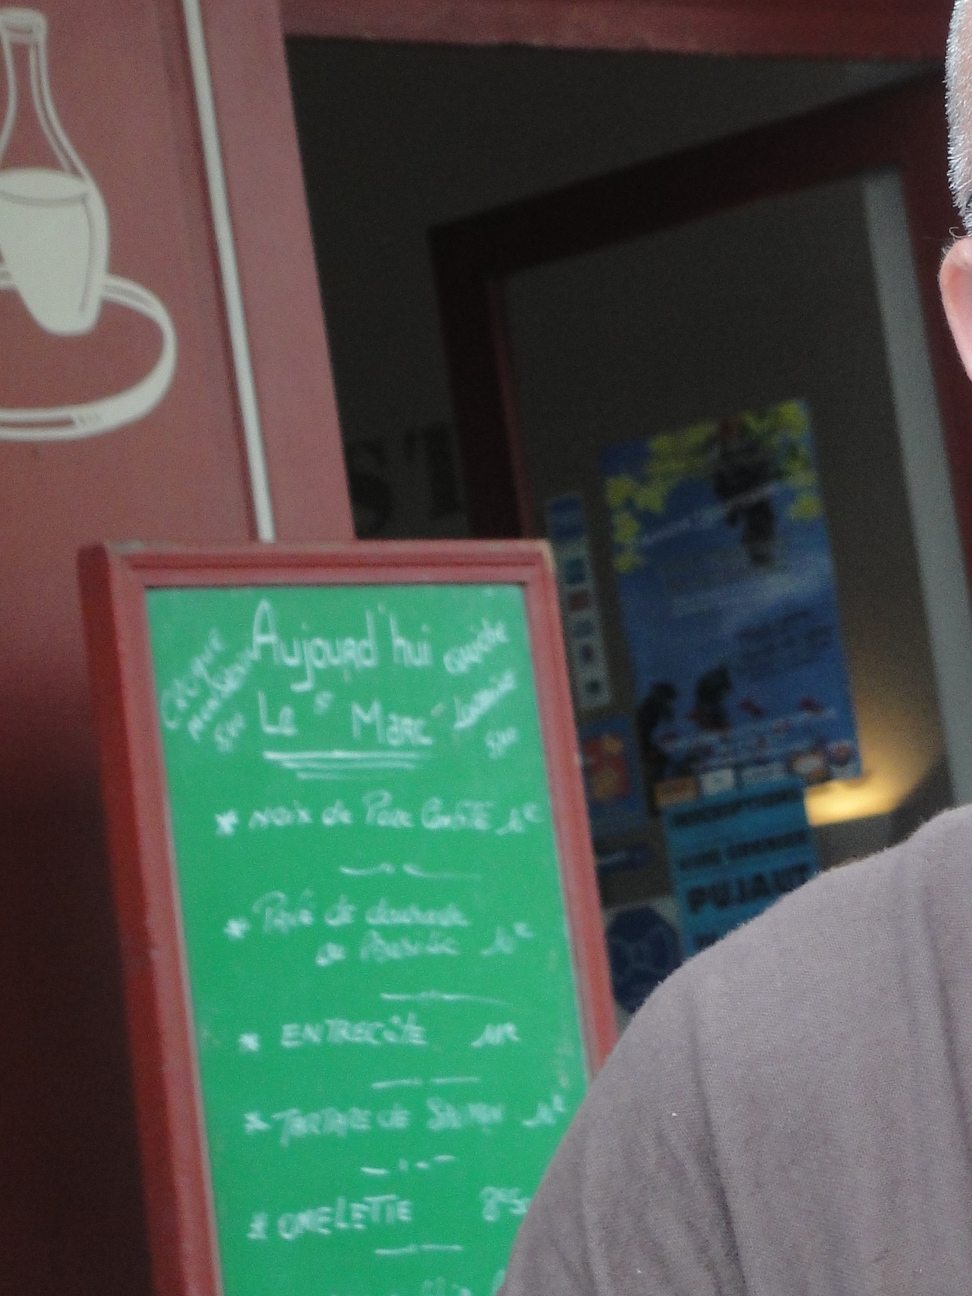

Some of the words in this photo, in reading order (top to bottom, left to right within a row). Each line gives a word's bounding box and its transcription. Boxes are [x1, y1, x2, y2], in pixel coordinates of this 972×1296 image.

[253, 599, 432, 692] Aujourd'hui
[257, 690, 298, 737] Le
[277, 1194, 413, 1241] OMELETTE
